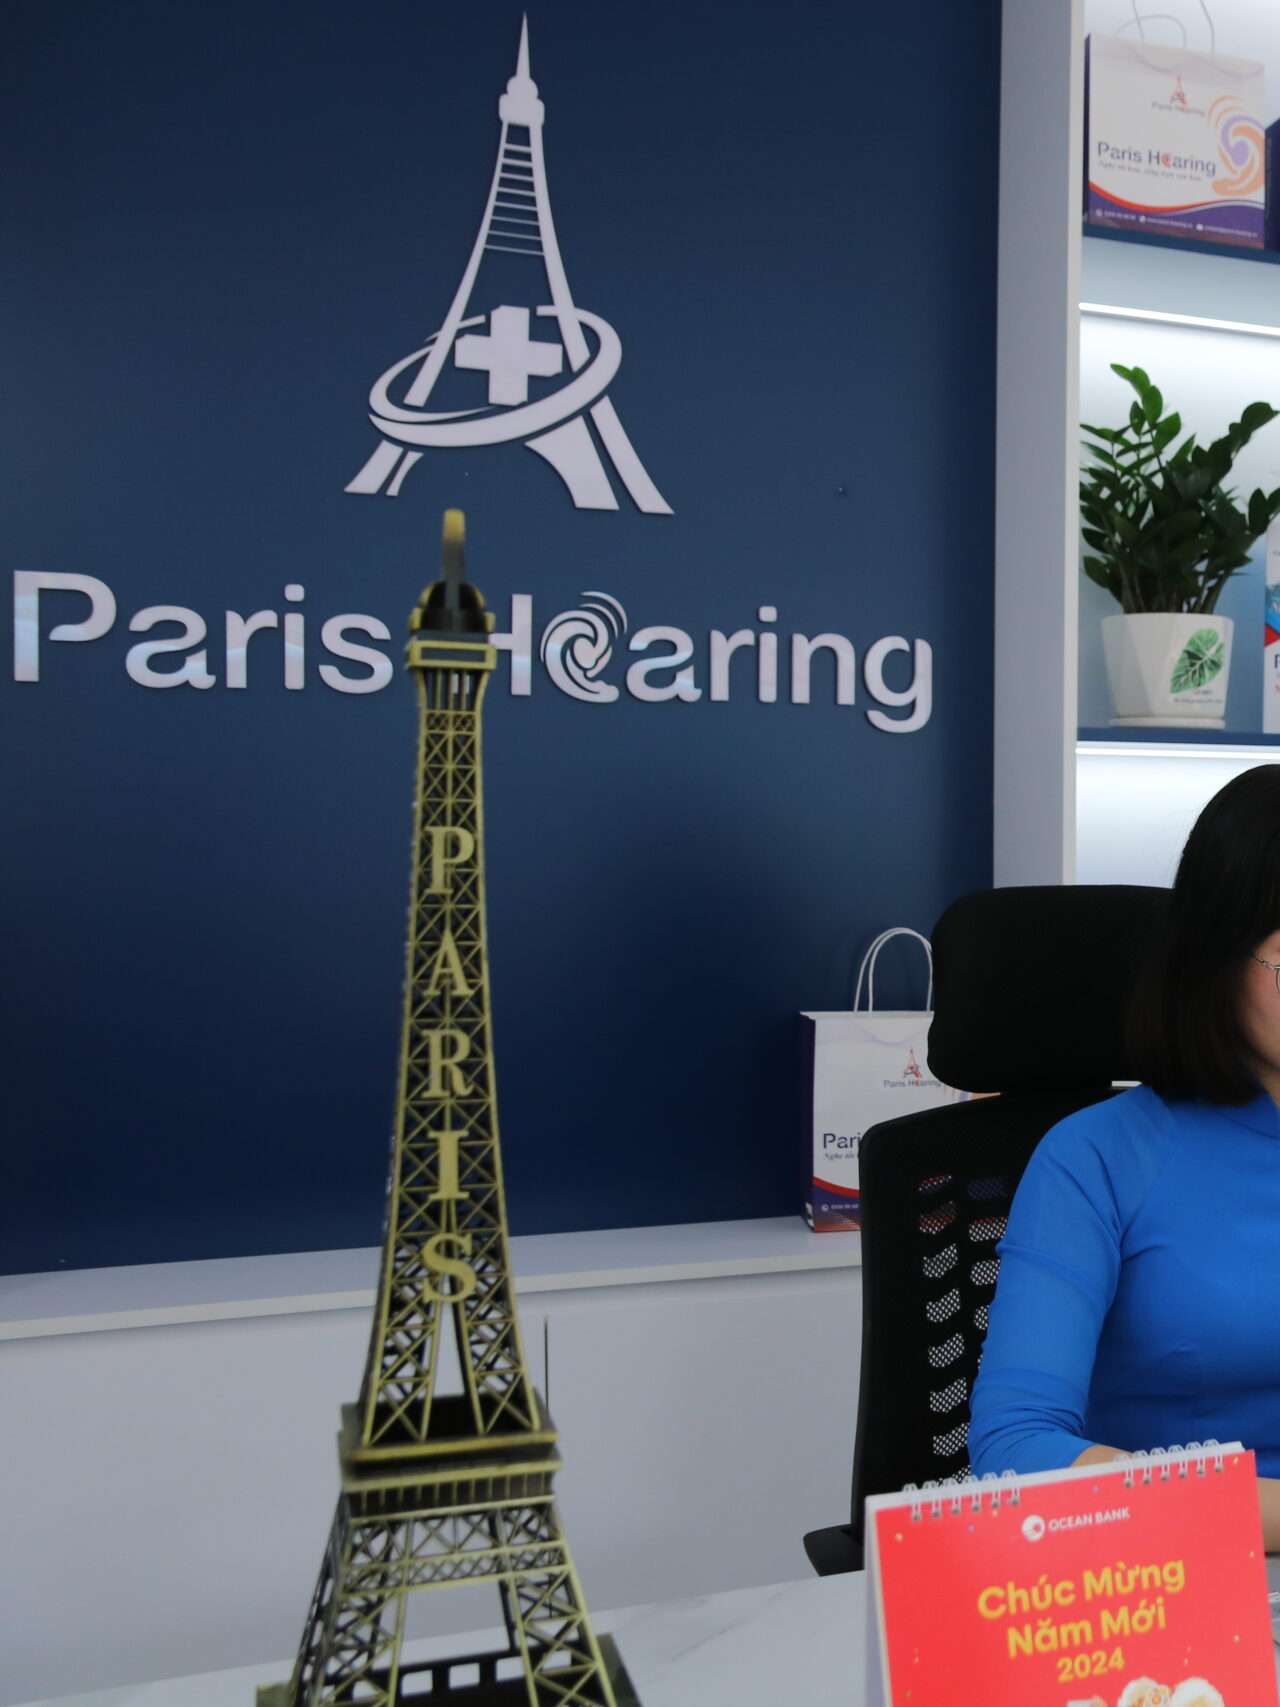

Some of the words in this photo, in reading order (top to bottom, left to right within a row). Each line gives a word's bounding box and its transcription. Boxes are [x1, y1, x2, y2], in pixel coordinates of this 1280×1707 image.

[1097, 141, 1143, 162] Paris
[1148, 148, 1216, 177] Hearing
[14, 570, 393, 694] Paris
[421, 826, 477, 1303] PARIS
[1048, 1514, 1093, 1532] OCEAN
[1096, 1507, 1130, 1525] BANK
[977, 1574, 1076, 1619] Chúc
[1083, 1559, 1185, 1601] Mừng
[1007, 1617, 1093, 1659] Năm
[1101, 1595, 1166, 1641] Mới
[1057, 1646, 1125, 1685] 2024
